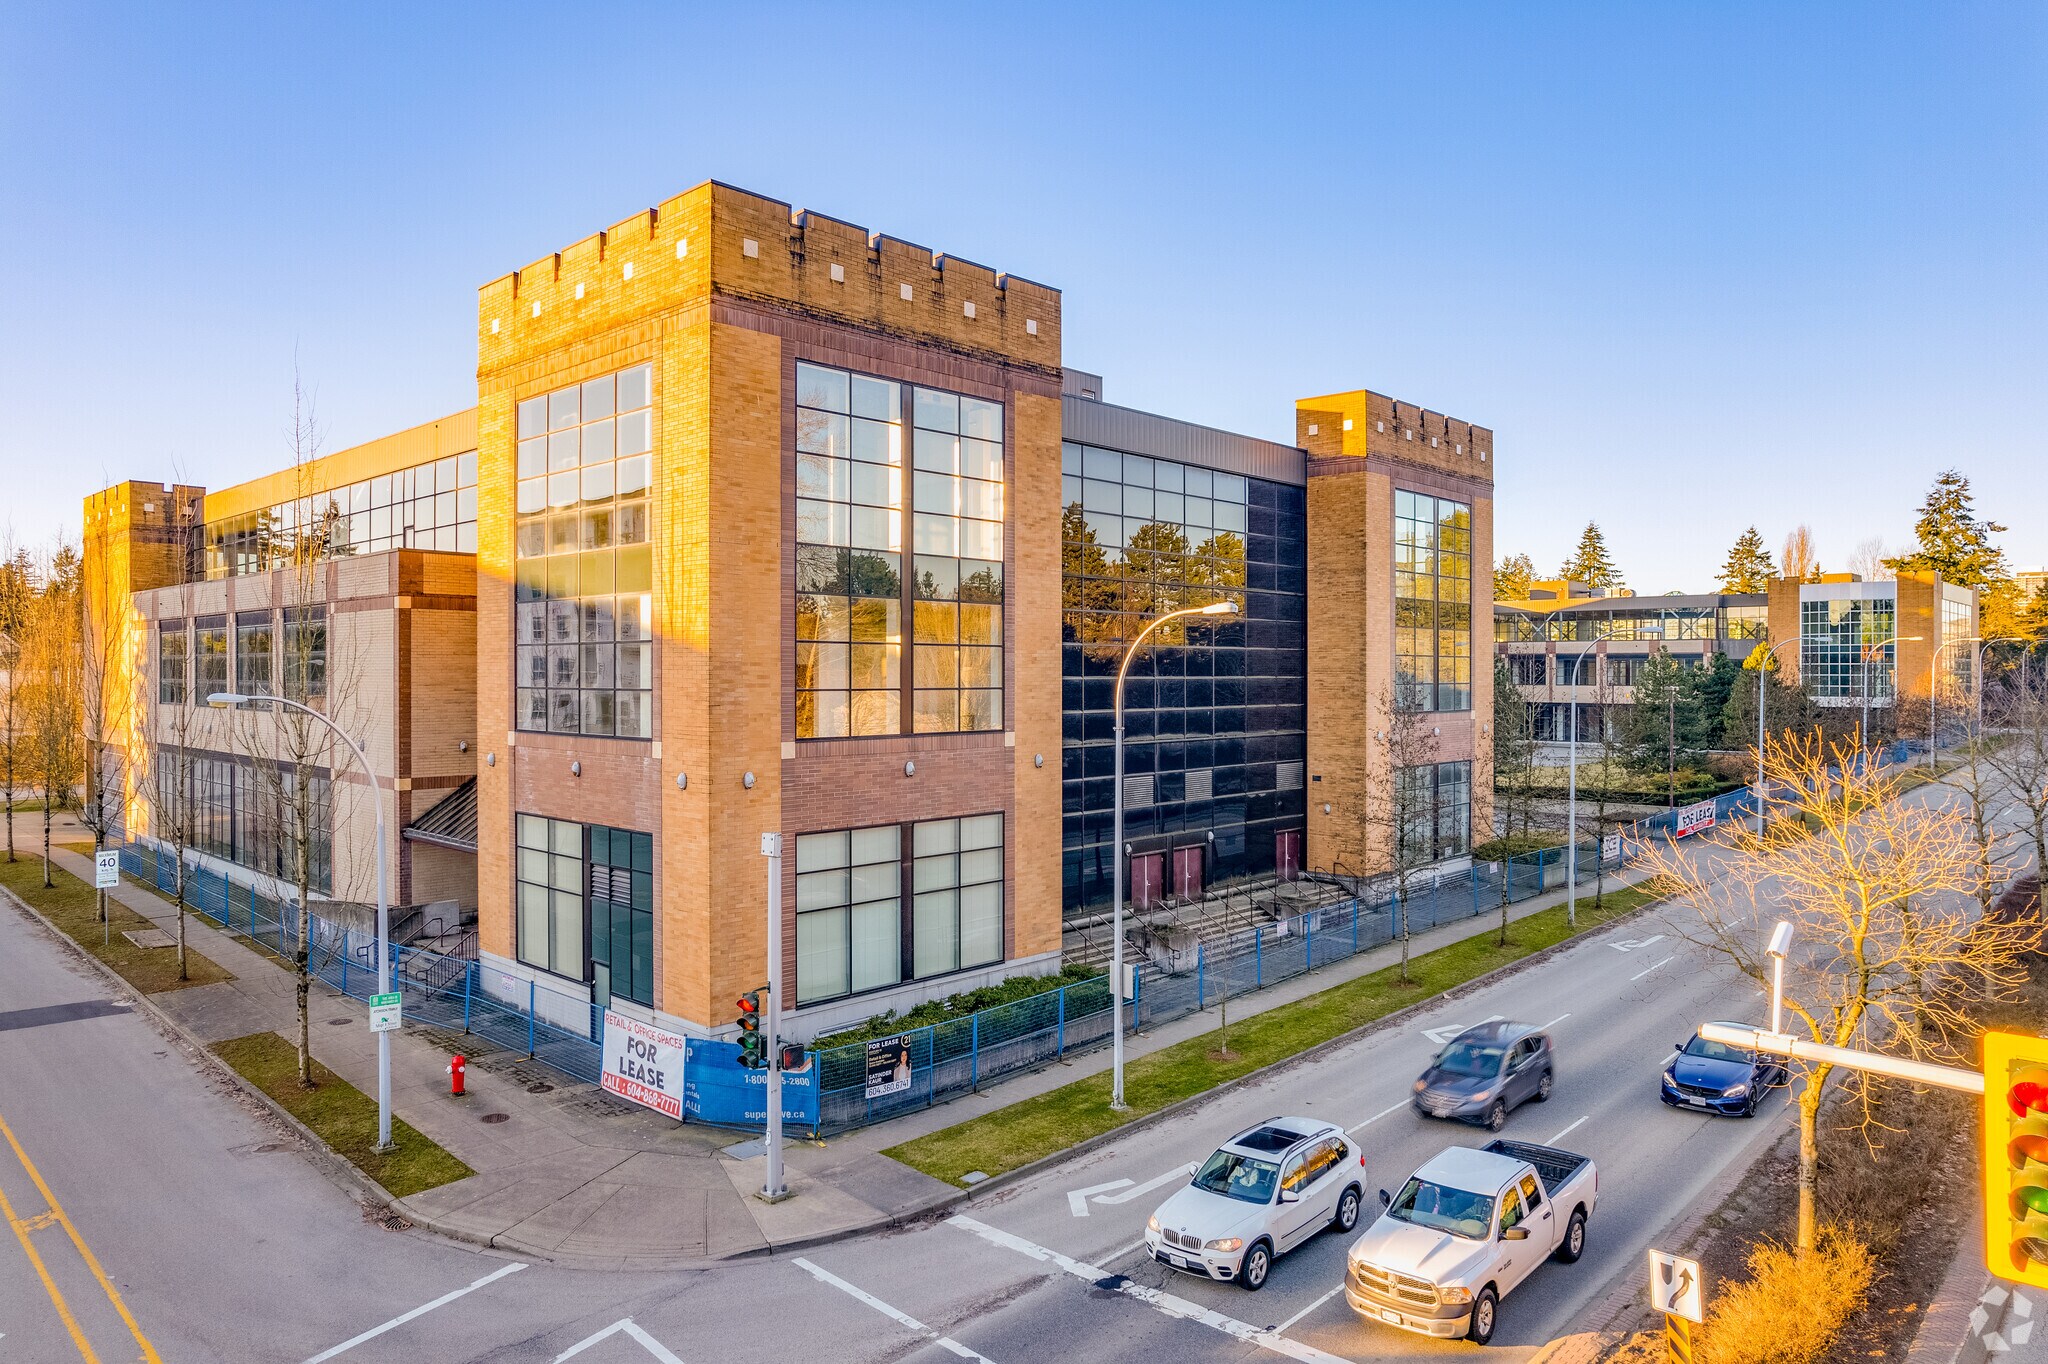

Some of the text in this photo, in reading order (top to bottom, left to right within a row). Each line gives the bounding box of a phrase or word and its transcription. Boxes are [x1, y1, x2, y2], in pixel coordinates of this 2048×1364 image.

[100, 858, 115, 867] 40
[605, 1014, 683, 1050] RETAIL & OFFICE SPACES
[881, 1038, 899, 1047] LEASE
[627, 1036, 657, 1064] FOR
[603, 1073, 620, 1092] CALL
[619, 1056, 665, 1090] LEASE
